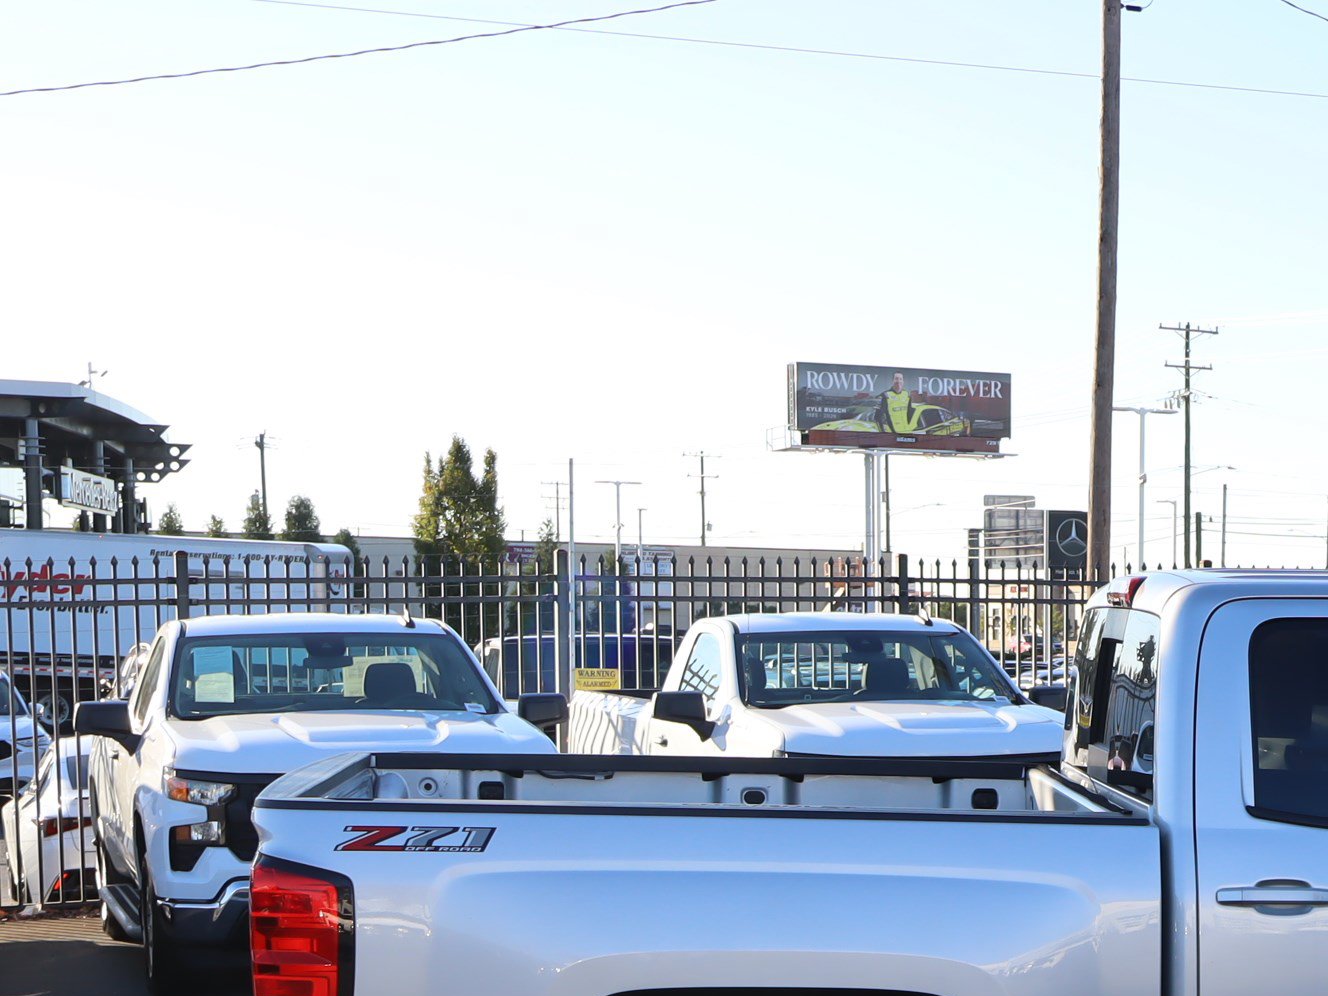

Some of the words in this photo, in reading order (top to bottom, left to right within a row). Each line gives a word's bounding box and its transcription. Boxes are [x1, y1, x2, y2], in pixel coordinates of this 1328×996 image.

[806, 370, 878, 392] ROWDY
[918, 376, 1003, 399] FOREVER
[71, 472, 118, 512] Mercedes-Benz
[0, 564, 96, 599] yder
[334, 825, 497, 852] Z71
